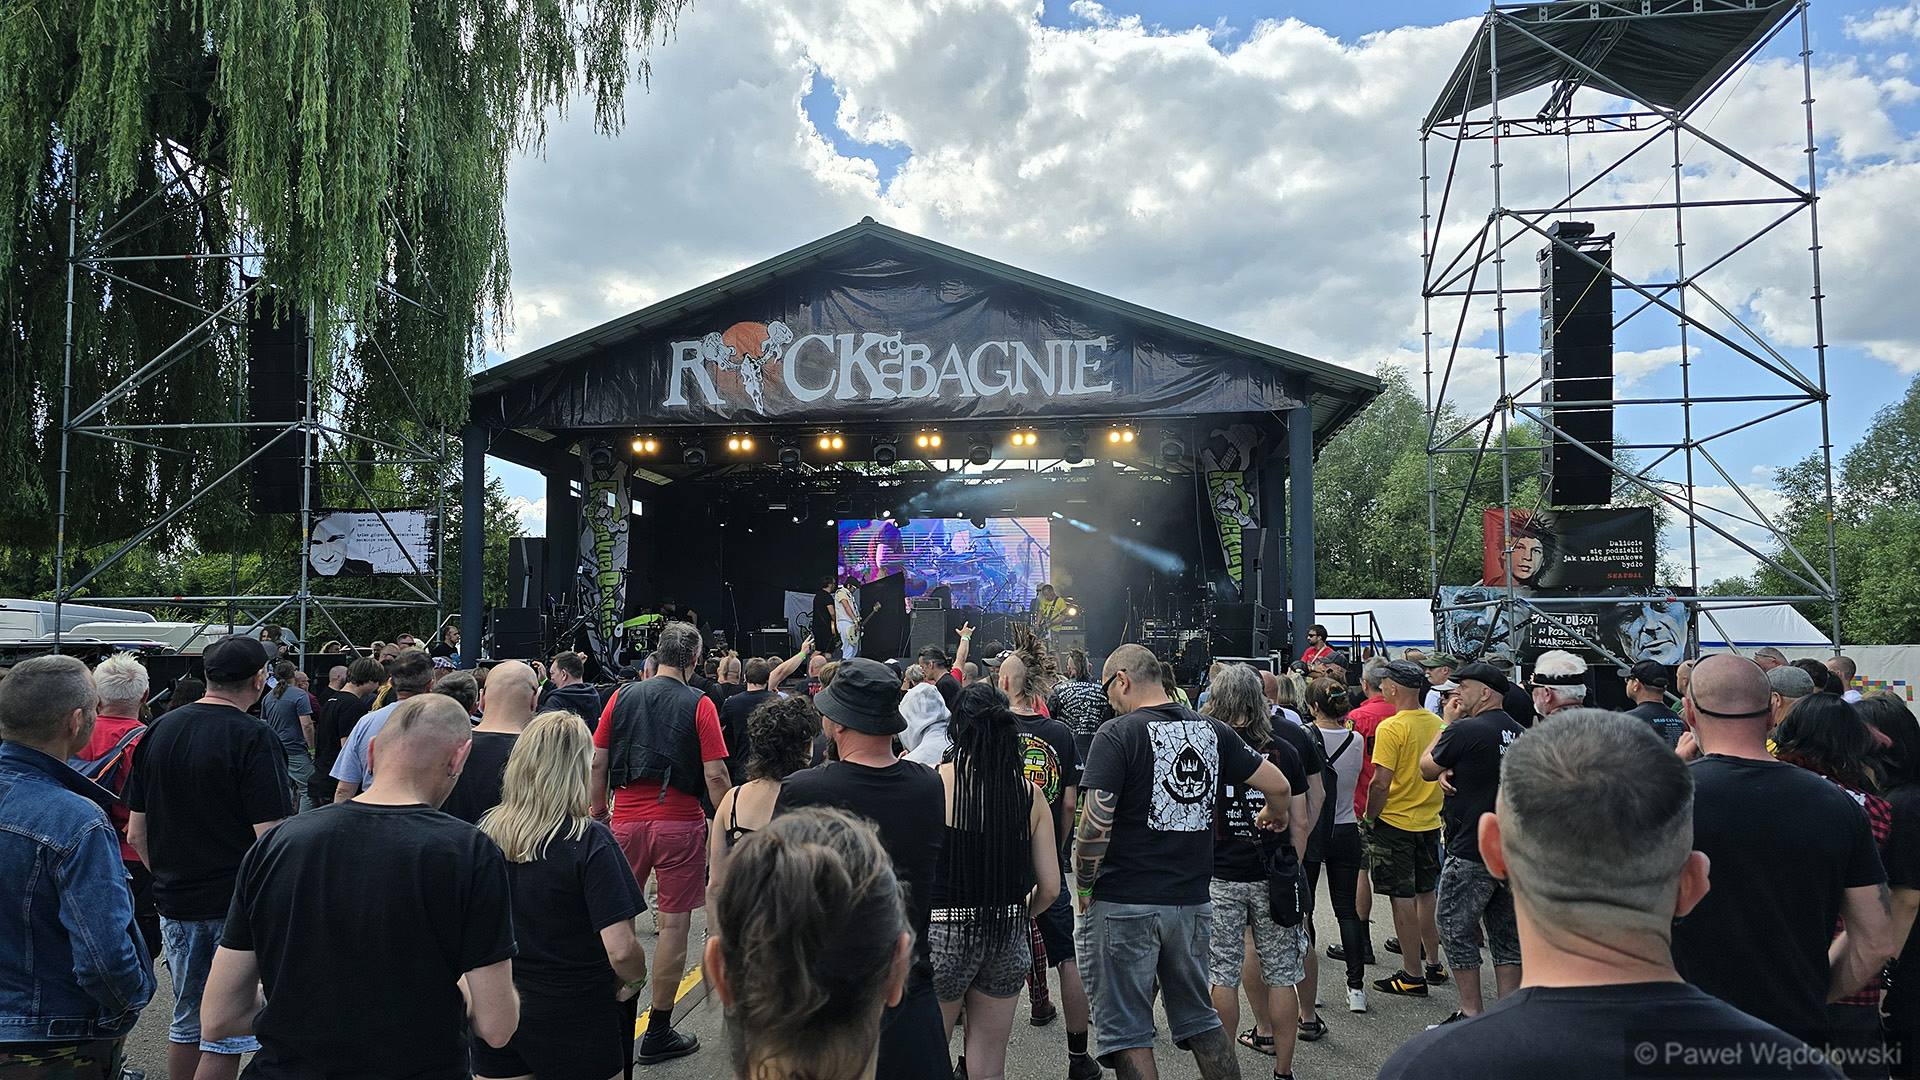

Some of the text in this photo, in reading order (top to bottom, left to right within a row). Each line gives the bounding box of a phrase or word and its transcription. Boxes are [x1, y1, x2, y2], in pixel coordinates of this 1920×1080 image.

[901, 336, 1112, 398] BAGNIE
[1563, 554, 1643, 563] jak wielogatunkowe
